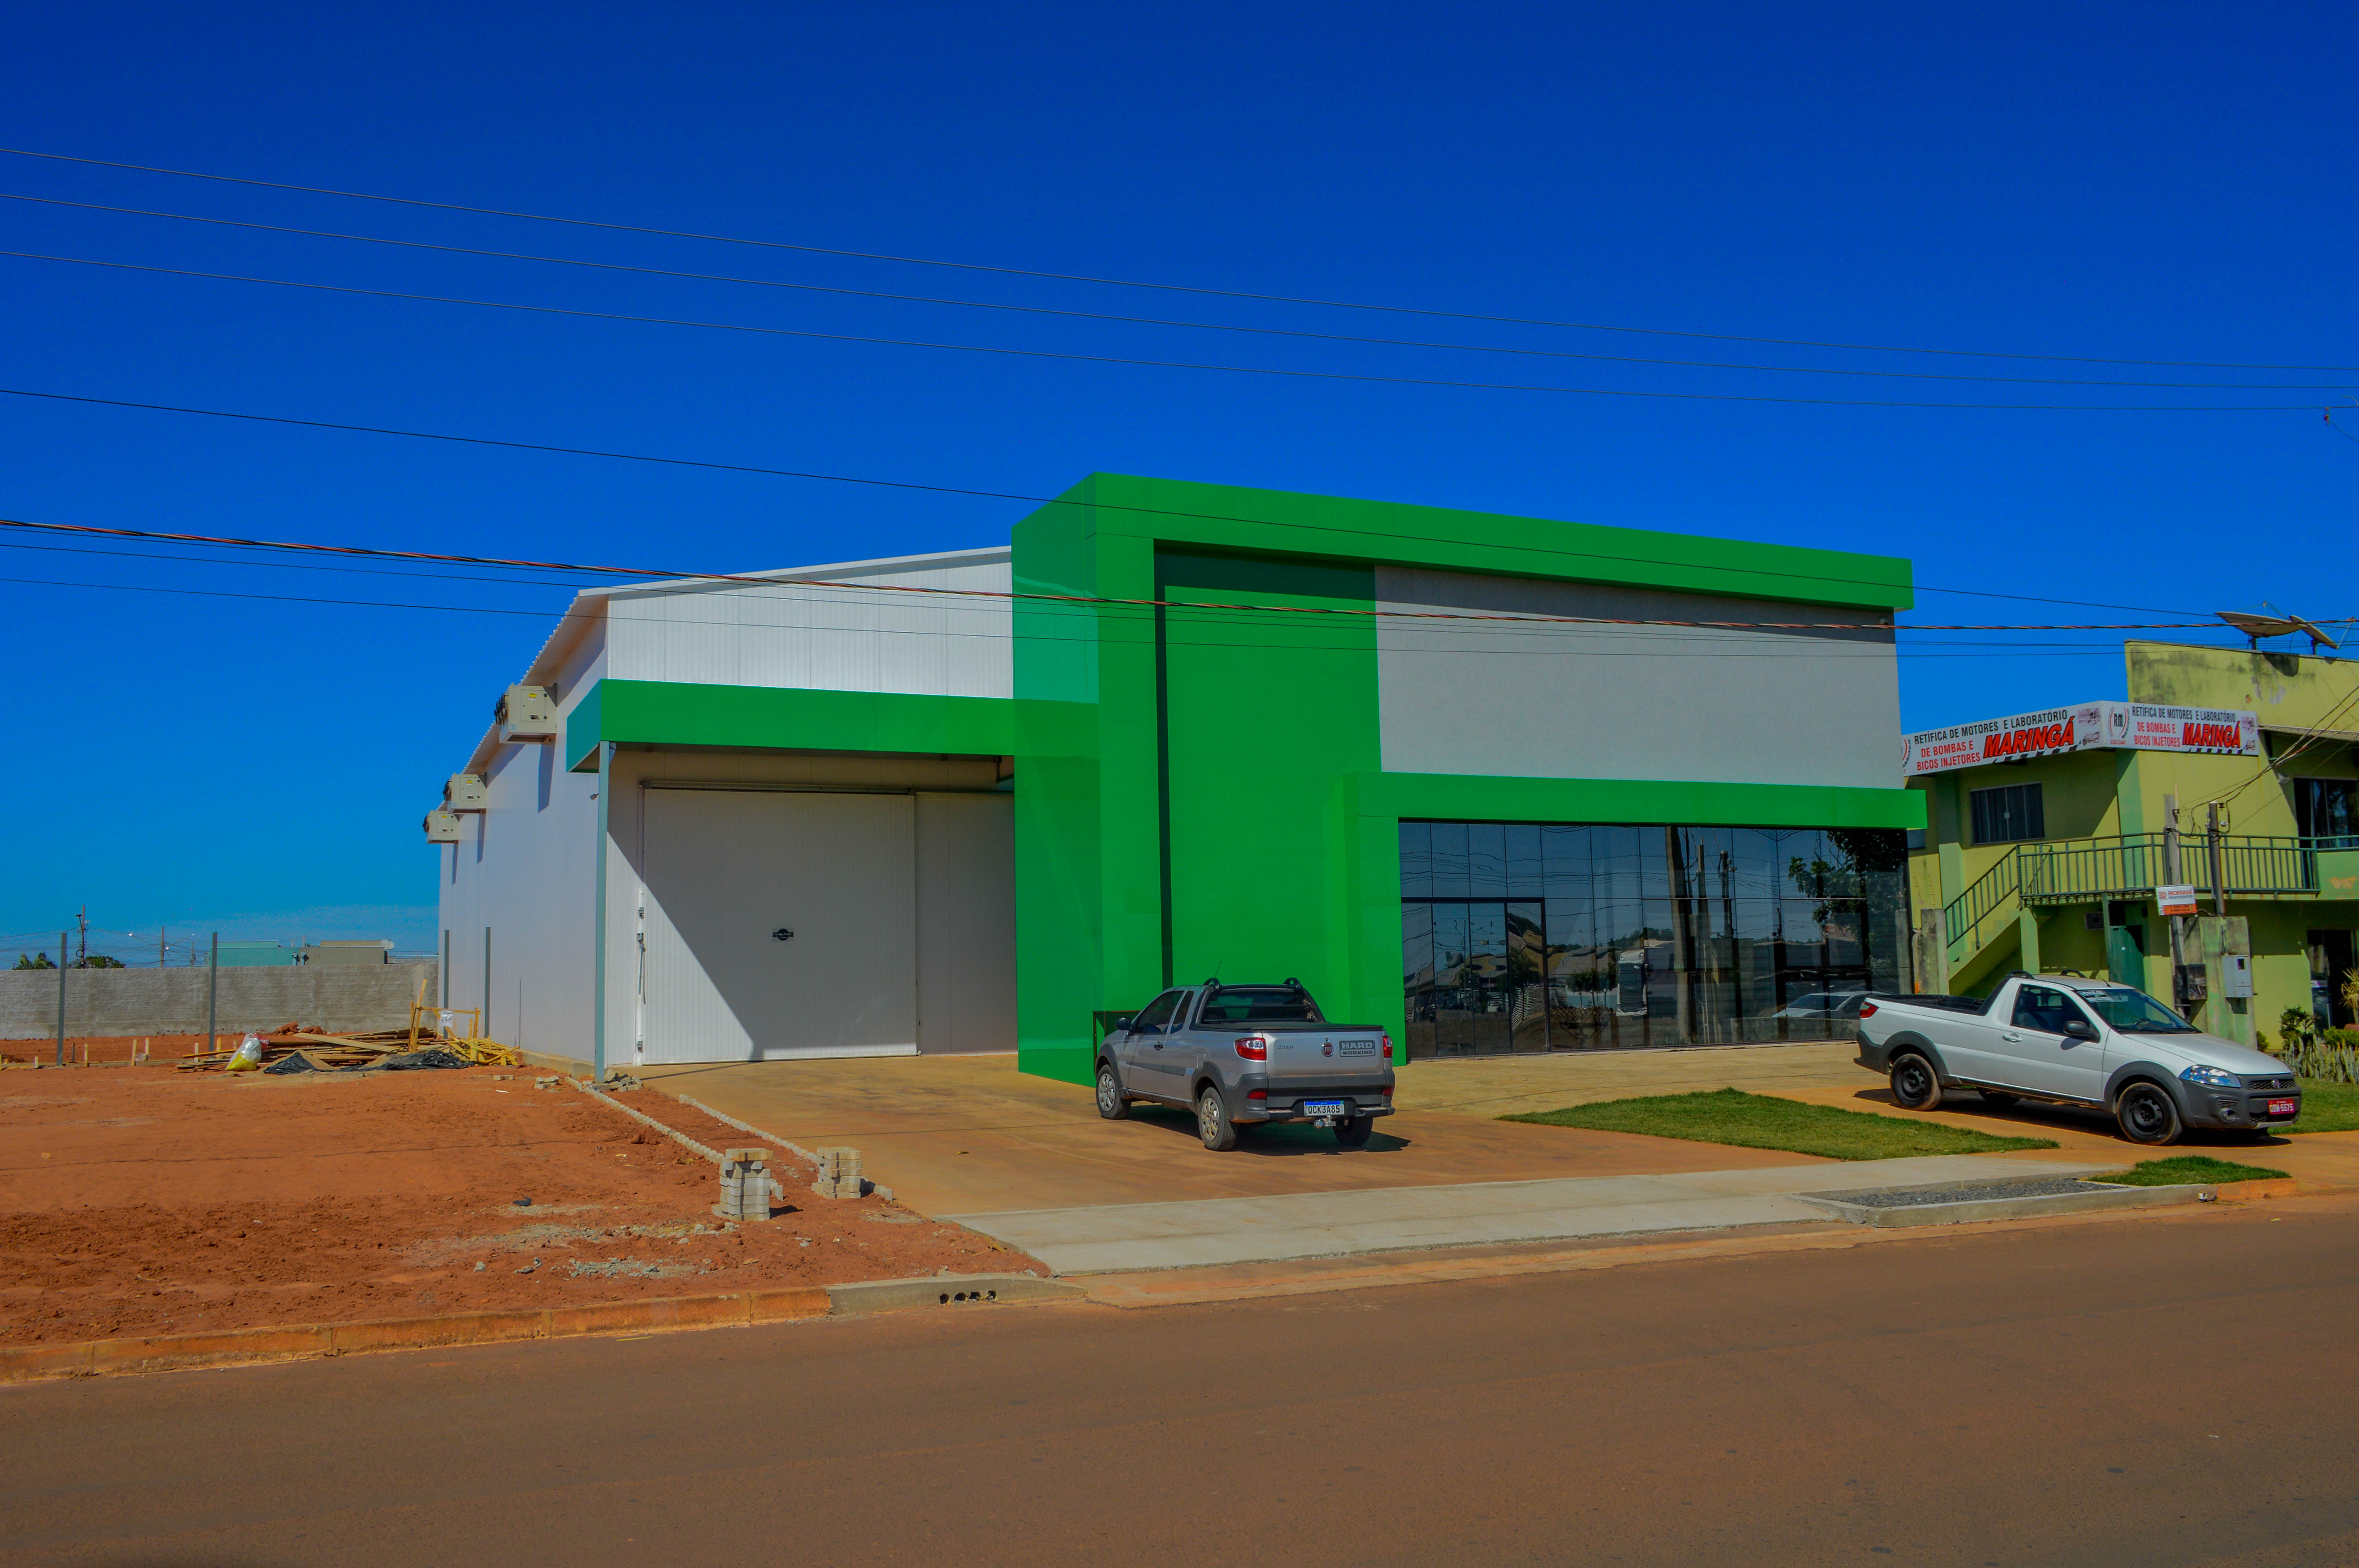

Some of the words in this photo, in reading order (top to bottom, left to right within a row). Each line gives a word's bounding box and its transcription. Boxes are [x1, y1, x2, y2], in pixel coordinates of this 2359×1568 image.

[2132, 704, 2157, 717] RETÍFICA
[2158, 708, 2165, 718] DE
[2167, 709, 2192, 720] MOTORES
[2195, 711, 2199, 720] E
[2200, 710, 2235, 722] LABORATÓRIO
[1914, 730, 1947, 745] RETÍFICA
[1949, 728, 1959, 739] DE
[1961, 721, 1998, 737] MOTORES
[2003, 720, 2008, 729] E
[2010, 710, 2067, 728] LABORATÓRIO
[2137, 722, 2145, 731] DE
[2146, 722, 2170, 733] BOMBAS
[2172, 724, 2176, 733] E
[2182, 720, 2241, 748] MARINGÁ
[1983, 715, 2075, 759] MARINGÁ
[2134, 735, 2150, 746] BICOS
[2152, 736, 2181, 747] INJETORES
[1921, 748, 1931, 758] DE
[1933, 740, 1966, 756] BOMBAS
[1968, 740, 1974, 750] E
[1917, 759, 1939, 771] BICOS
[1941, 752, 1981, 768] INJETORES
[1308, 1105, 1340, 1114] QCK3A85
